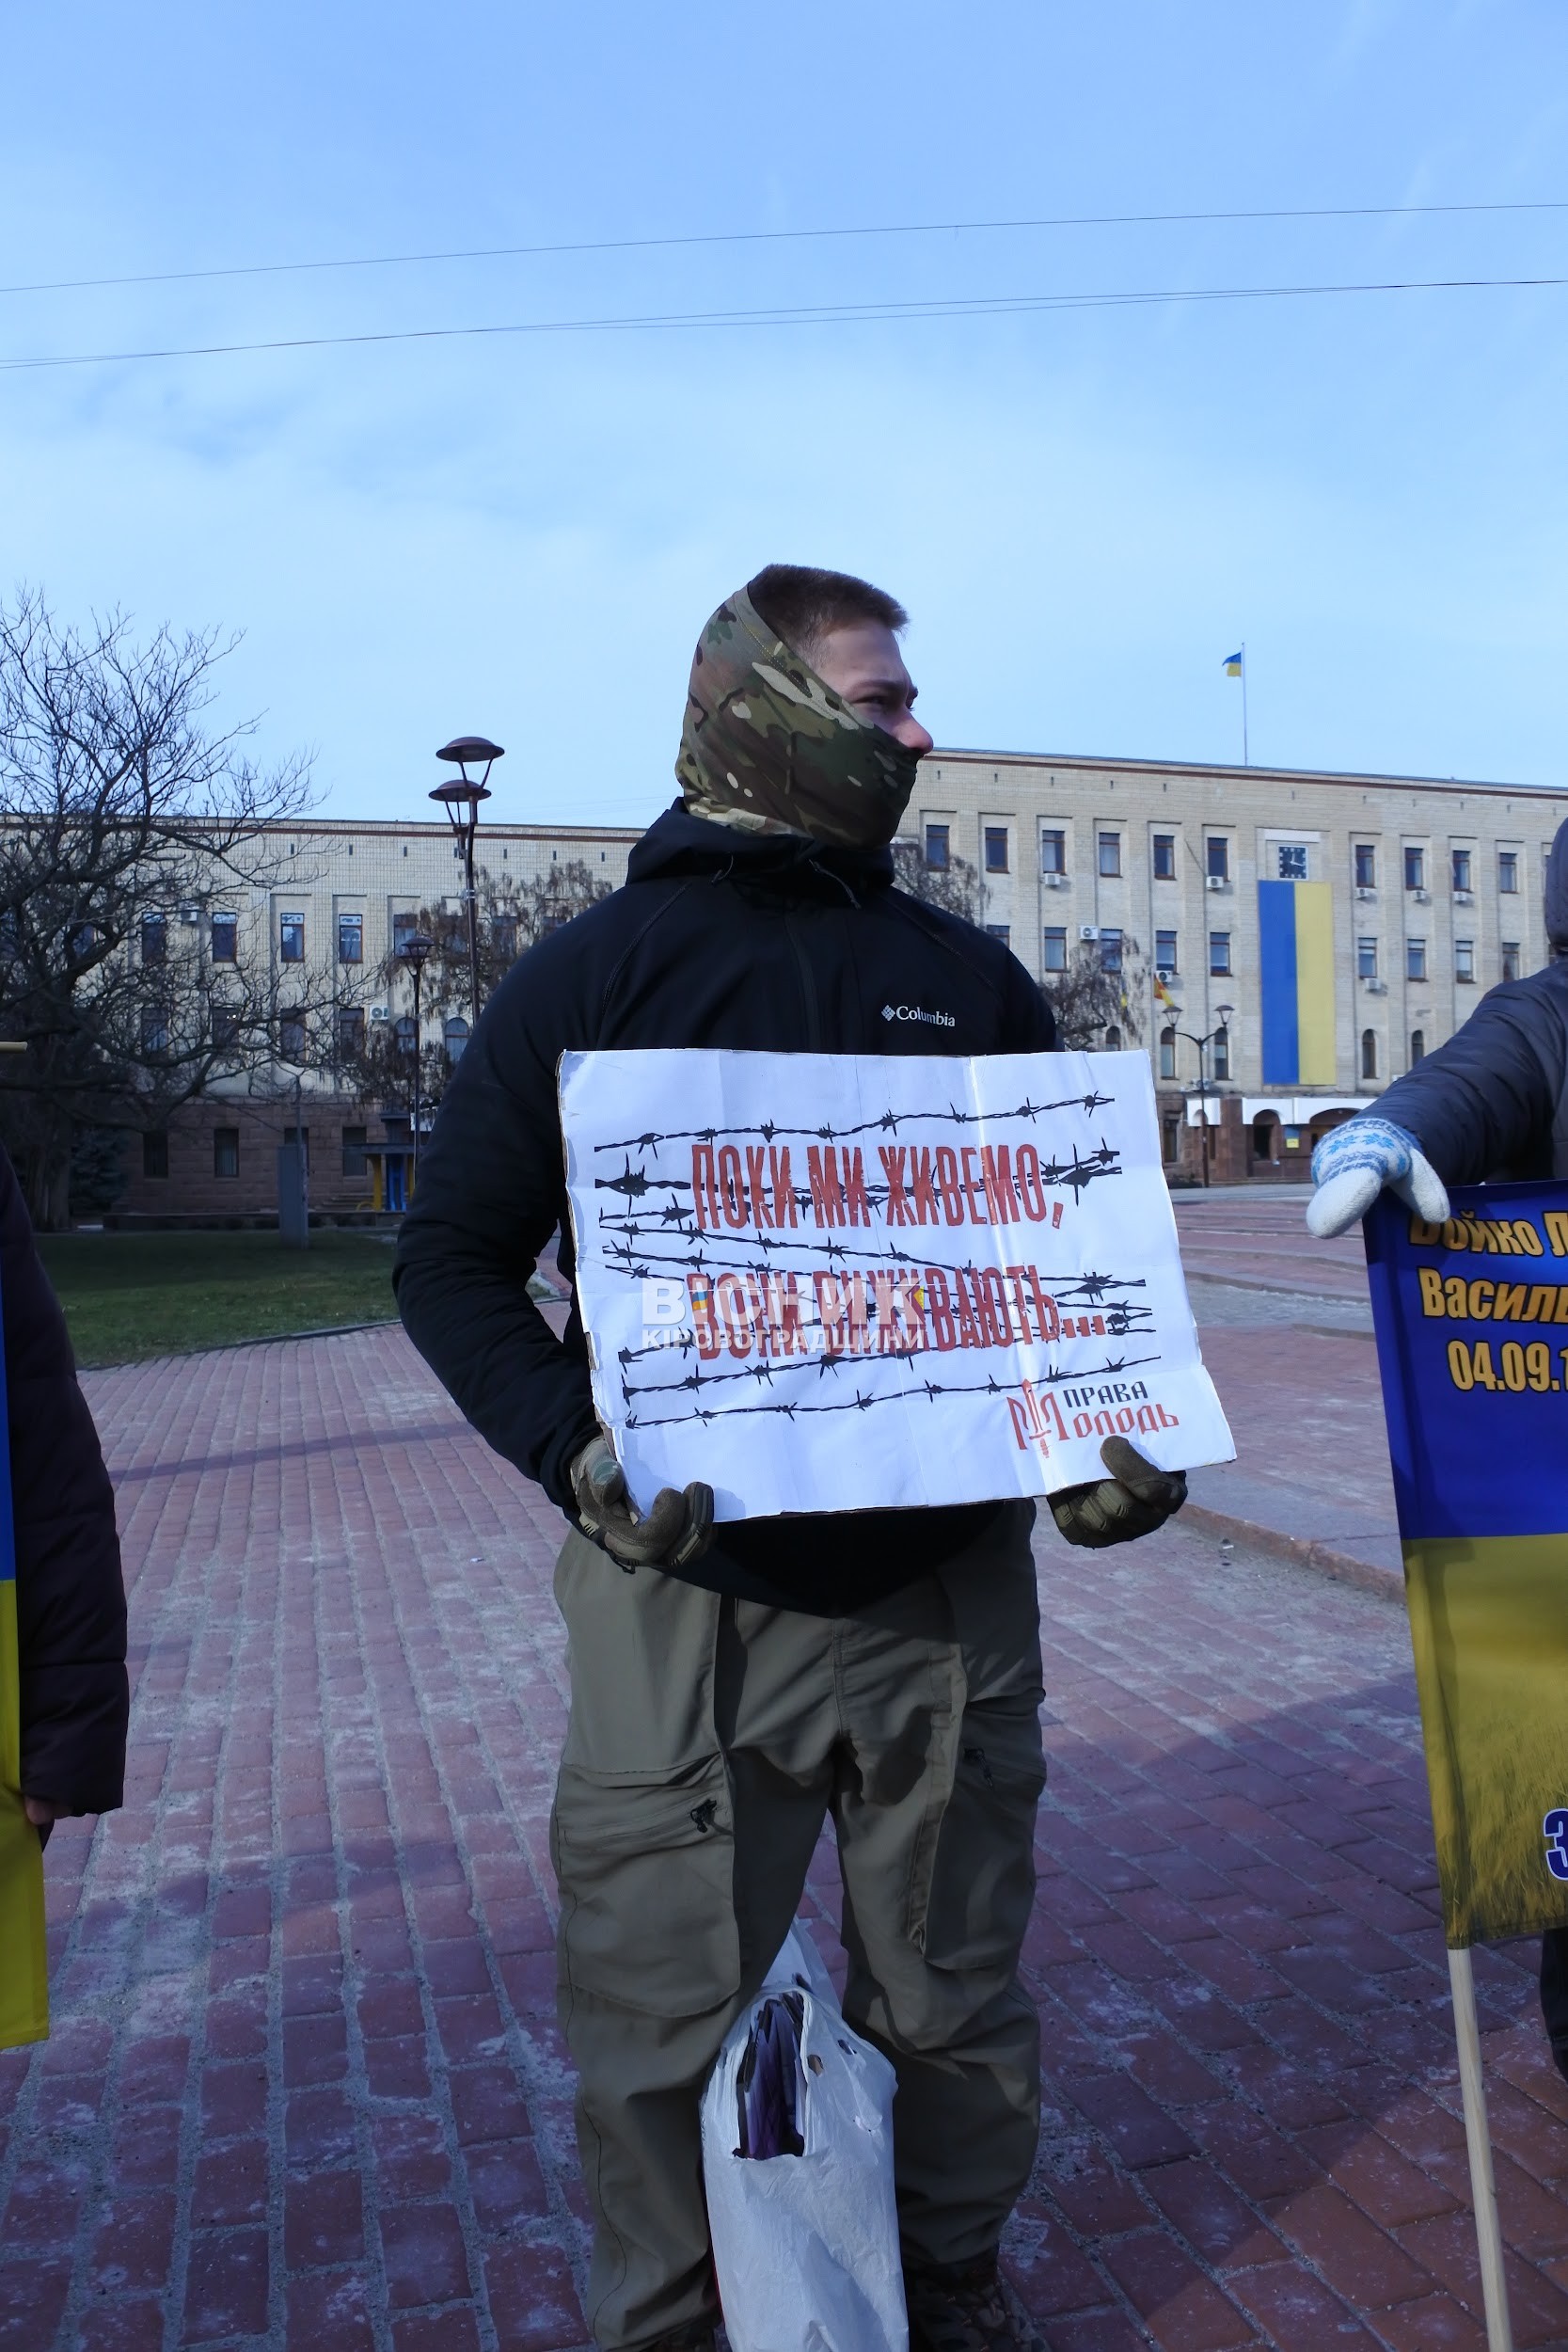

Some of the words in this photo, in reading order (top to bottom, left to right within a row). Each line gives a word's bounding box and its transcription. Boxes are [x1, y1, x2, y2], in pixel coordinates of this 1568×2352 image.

[895, 1006, 956, 1026] Columbia
[691, 1144, 799, 1230] ПОКИ
[807, 1145, 871, 1229] МИ
[878, 1143, 1064, 1230] ЖИВЕМО,
[1063, 1380, 1148, 1408] ПРАВА
